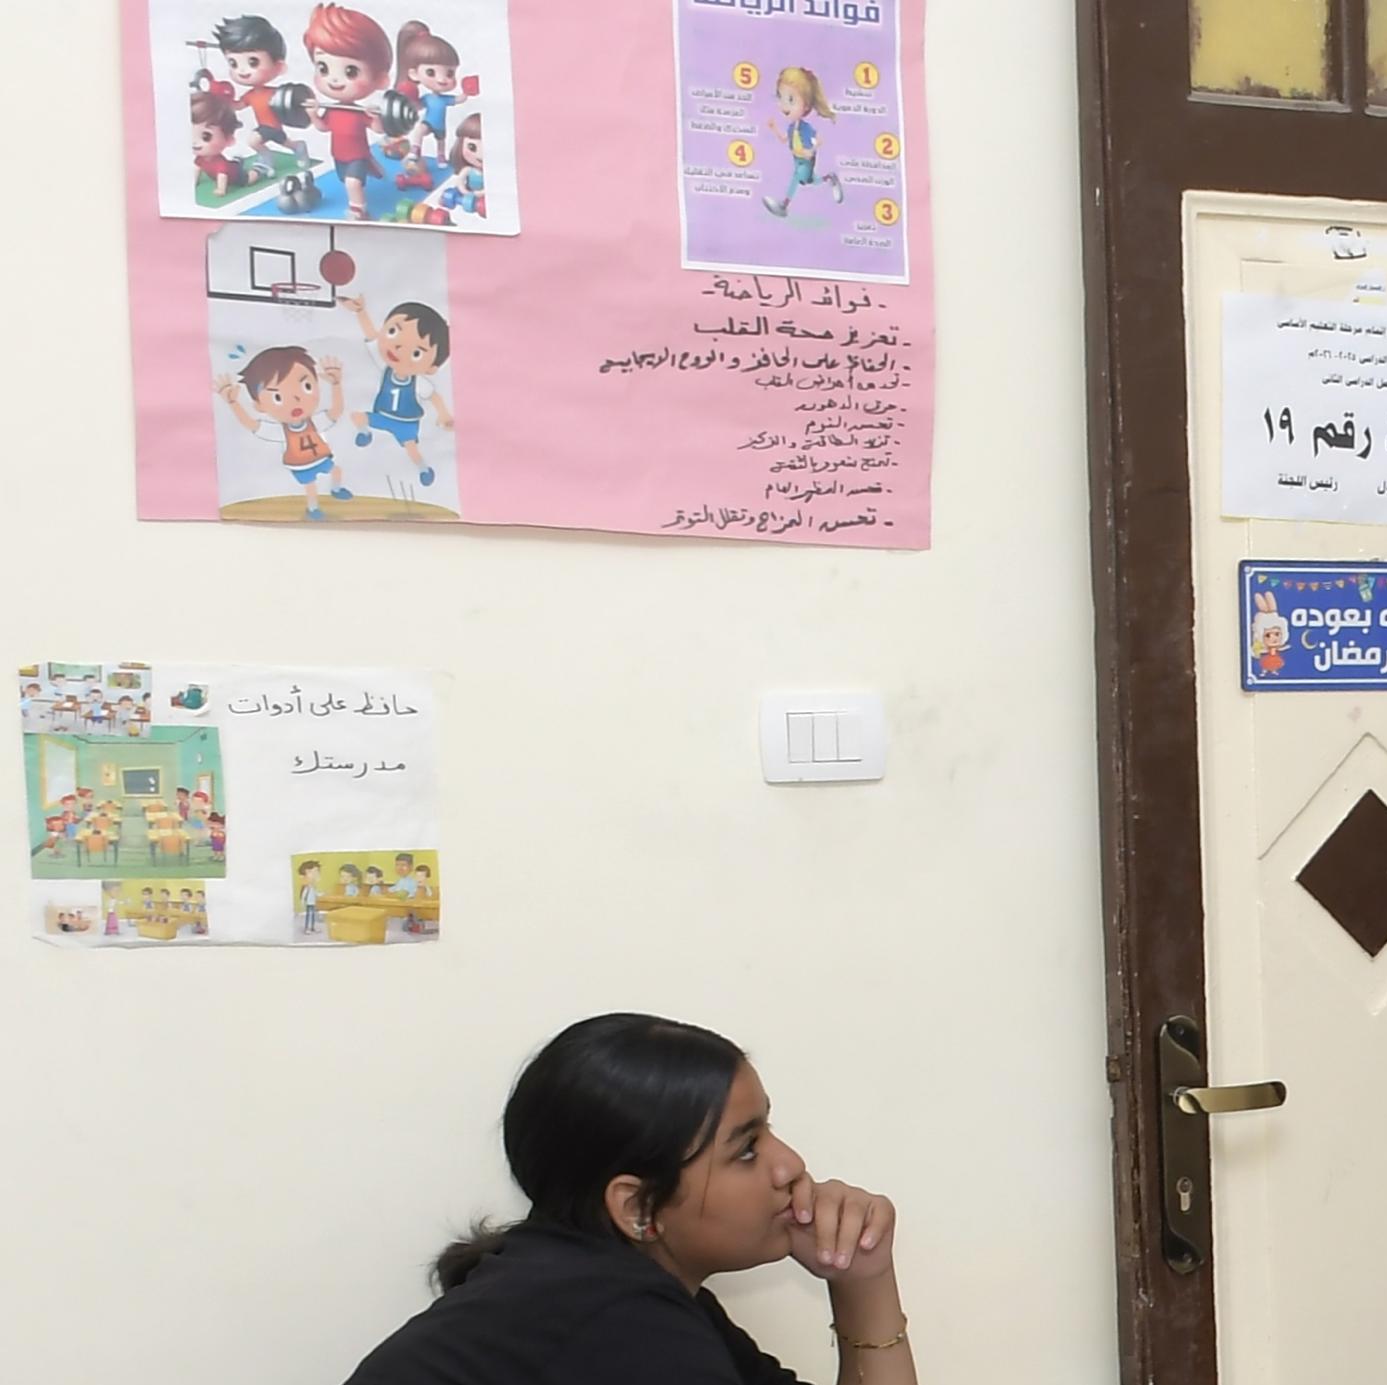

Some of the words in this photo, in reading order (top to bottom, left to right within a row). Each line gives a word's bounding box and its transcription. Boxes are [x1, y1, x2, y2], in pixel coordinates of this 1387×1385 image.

[741, 67, 752, 84] 5
[862, 67, 872, 84] 1
[734, 144, 747, 162] 4
[881, 138, 893, 155] 2
[881, 203, 893, 221] 3
[693, 315, 769, 342] القلب
[391, 388, 400, 412] 1
[1263, 406, 1295, 445] ١٩
[1312, 412, 1372, 460] رقم
[300, 434, 318, 457] 4
[1277, 472, 1307, 490] اللجنة
[1309, 476, 1338, 492] رئيس
[1291, 607, 1372, 635] بعوده
[228, 684, 303, 718] أدوات
[309, 692, 348, 716] على
[290, 750, 407, 778] مدرستك
